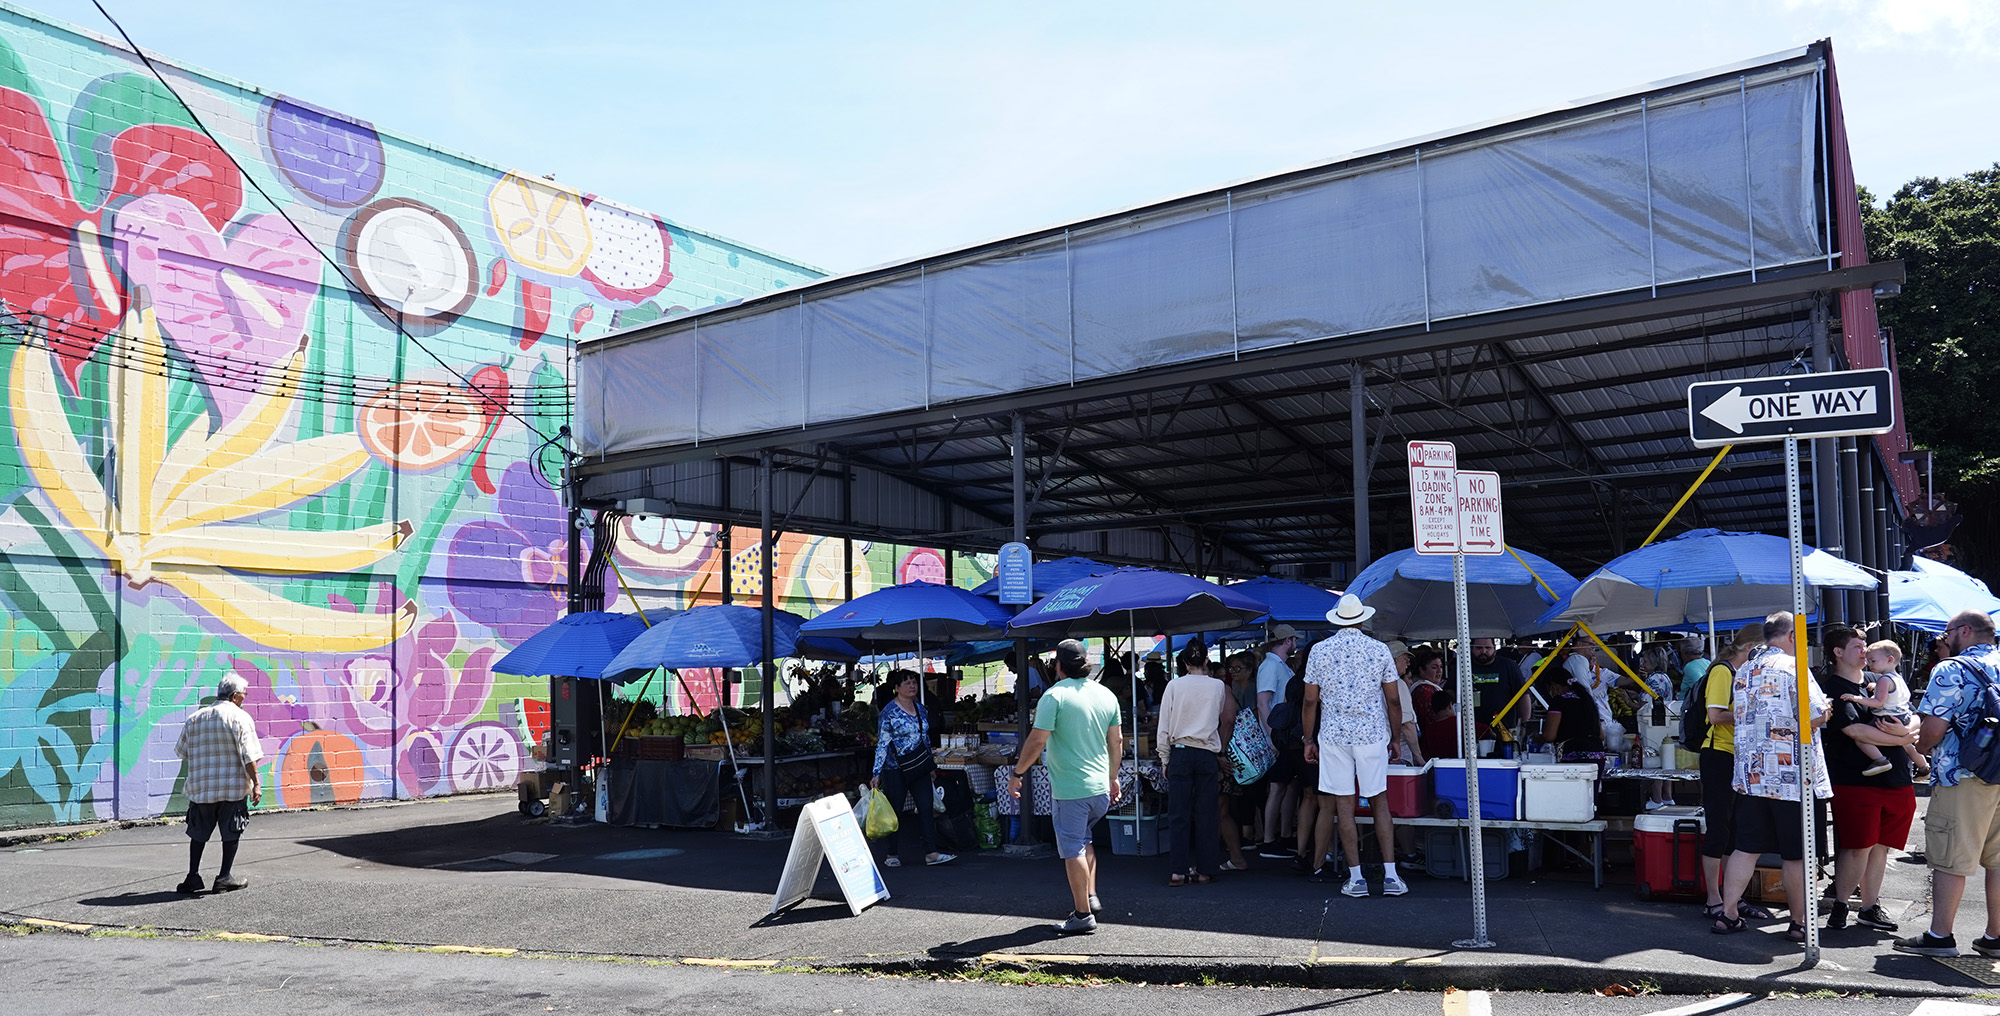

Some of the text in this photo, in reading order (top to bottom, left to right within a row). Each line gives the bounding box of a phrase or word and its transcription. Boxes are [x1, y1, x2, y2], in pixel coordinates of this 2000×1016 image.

[1749, 389, 1868, 419] ONE WAY
[1410, 447, 1453, 463] NO PARKING
[1421, 470, 1446, 481] 15 MIN
[1417, 481, 1452, 492] LOADING
[1469, 479, 1485, 494] NO
[1424, 493, 1446, 504] ZONE
[1460, 497, 1498, 513] PARKING
[1471, 514, 1488, 525] ANY
[1470, 526, 1491, 537] TIME
[1052, 583, 1102, 601] TOMMY
